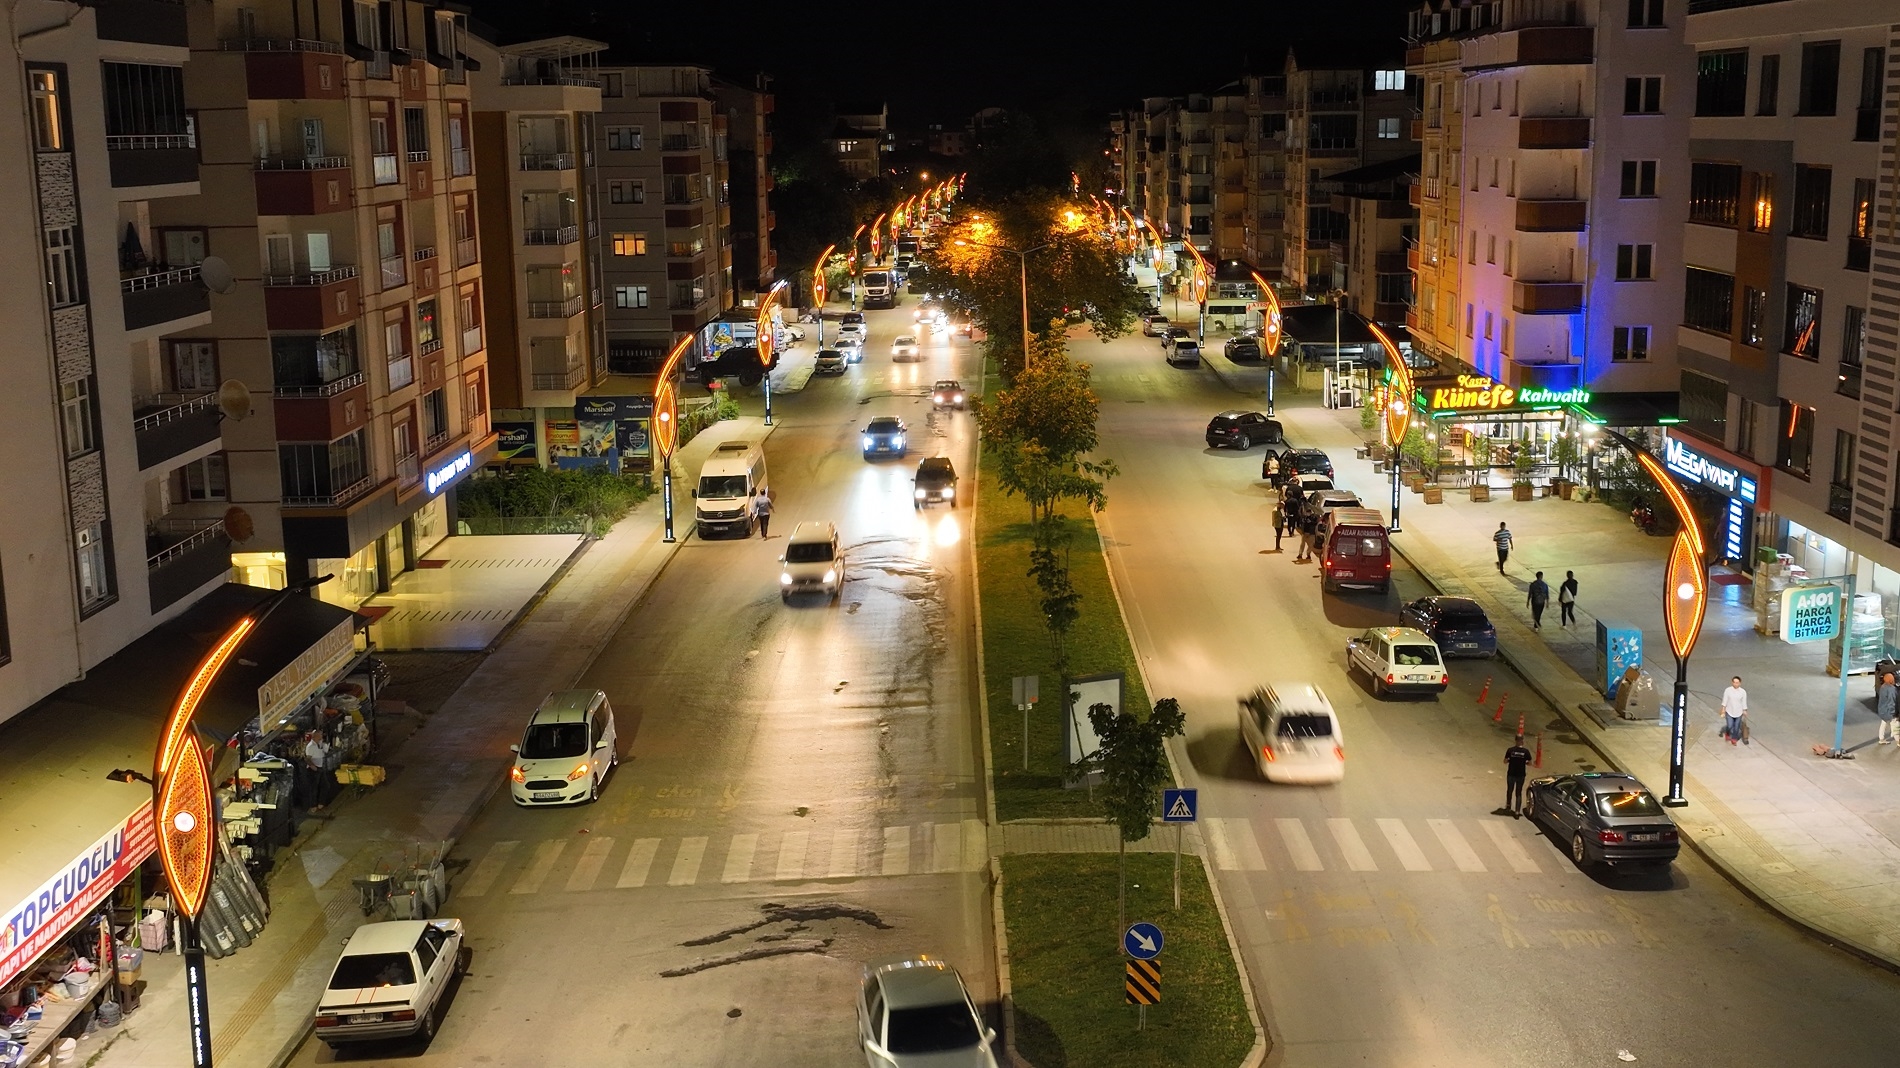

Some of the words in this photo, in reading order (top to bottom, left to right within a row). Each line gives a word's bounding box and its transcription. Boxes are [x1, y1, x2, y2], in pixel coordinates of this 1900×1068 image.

[1433, 384, 1514, 409] Künefe
[1519, 388, 1590, 403] Kahvaltı
[584, 405, 614, 413] Marshall
[1796, 606, 1832, 619] HARCA
[1795, 615, 1832, 628] HARCA
[20, 939, 35, 961] VE
[34, 889, 94, 951] MANTOLAMA
